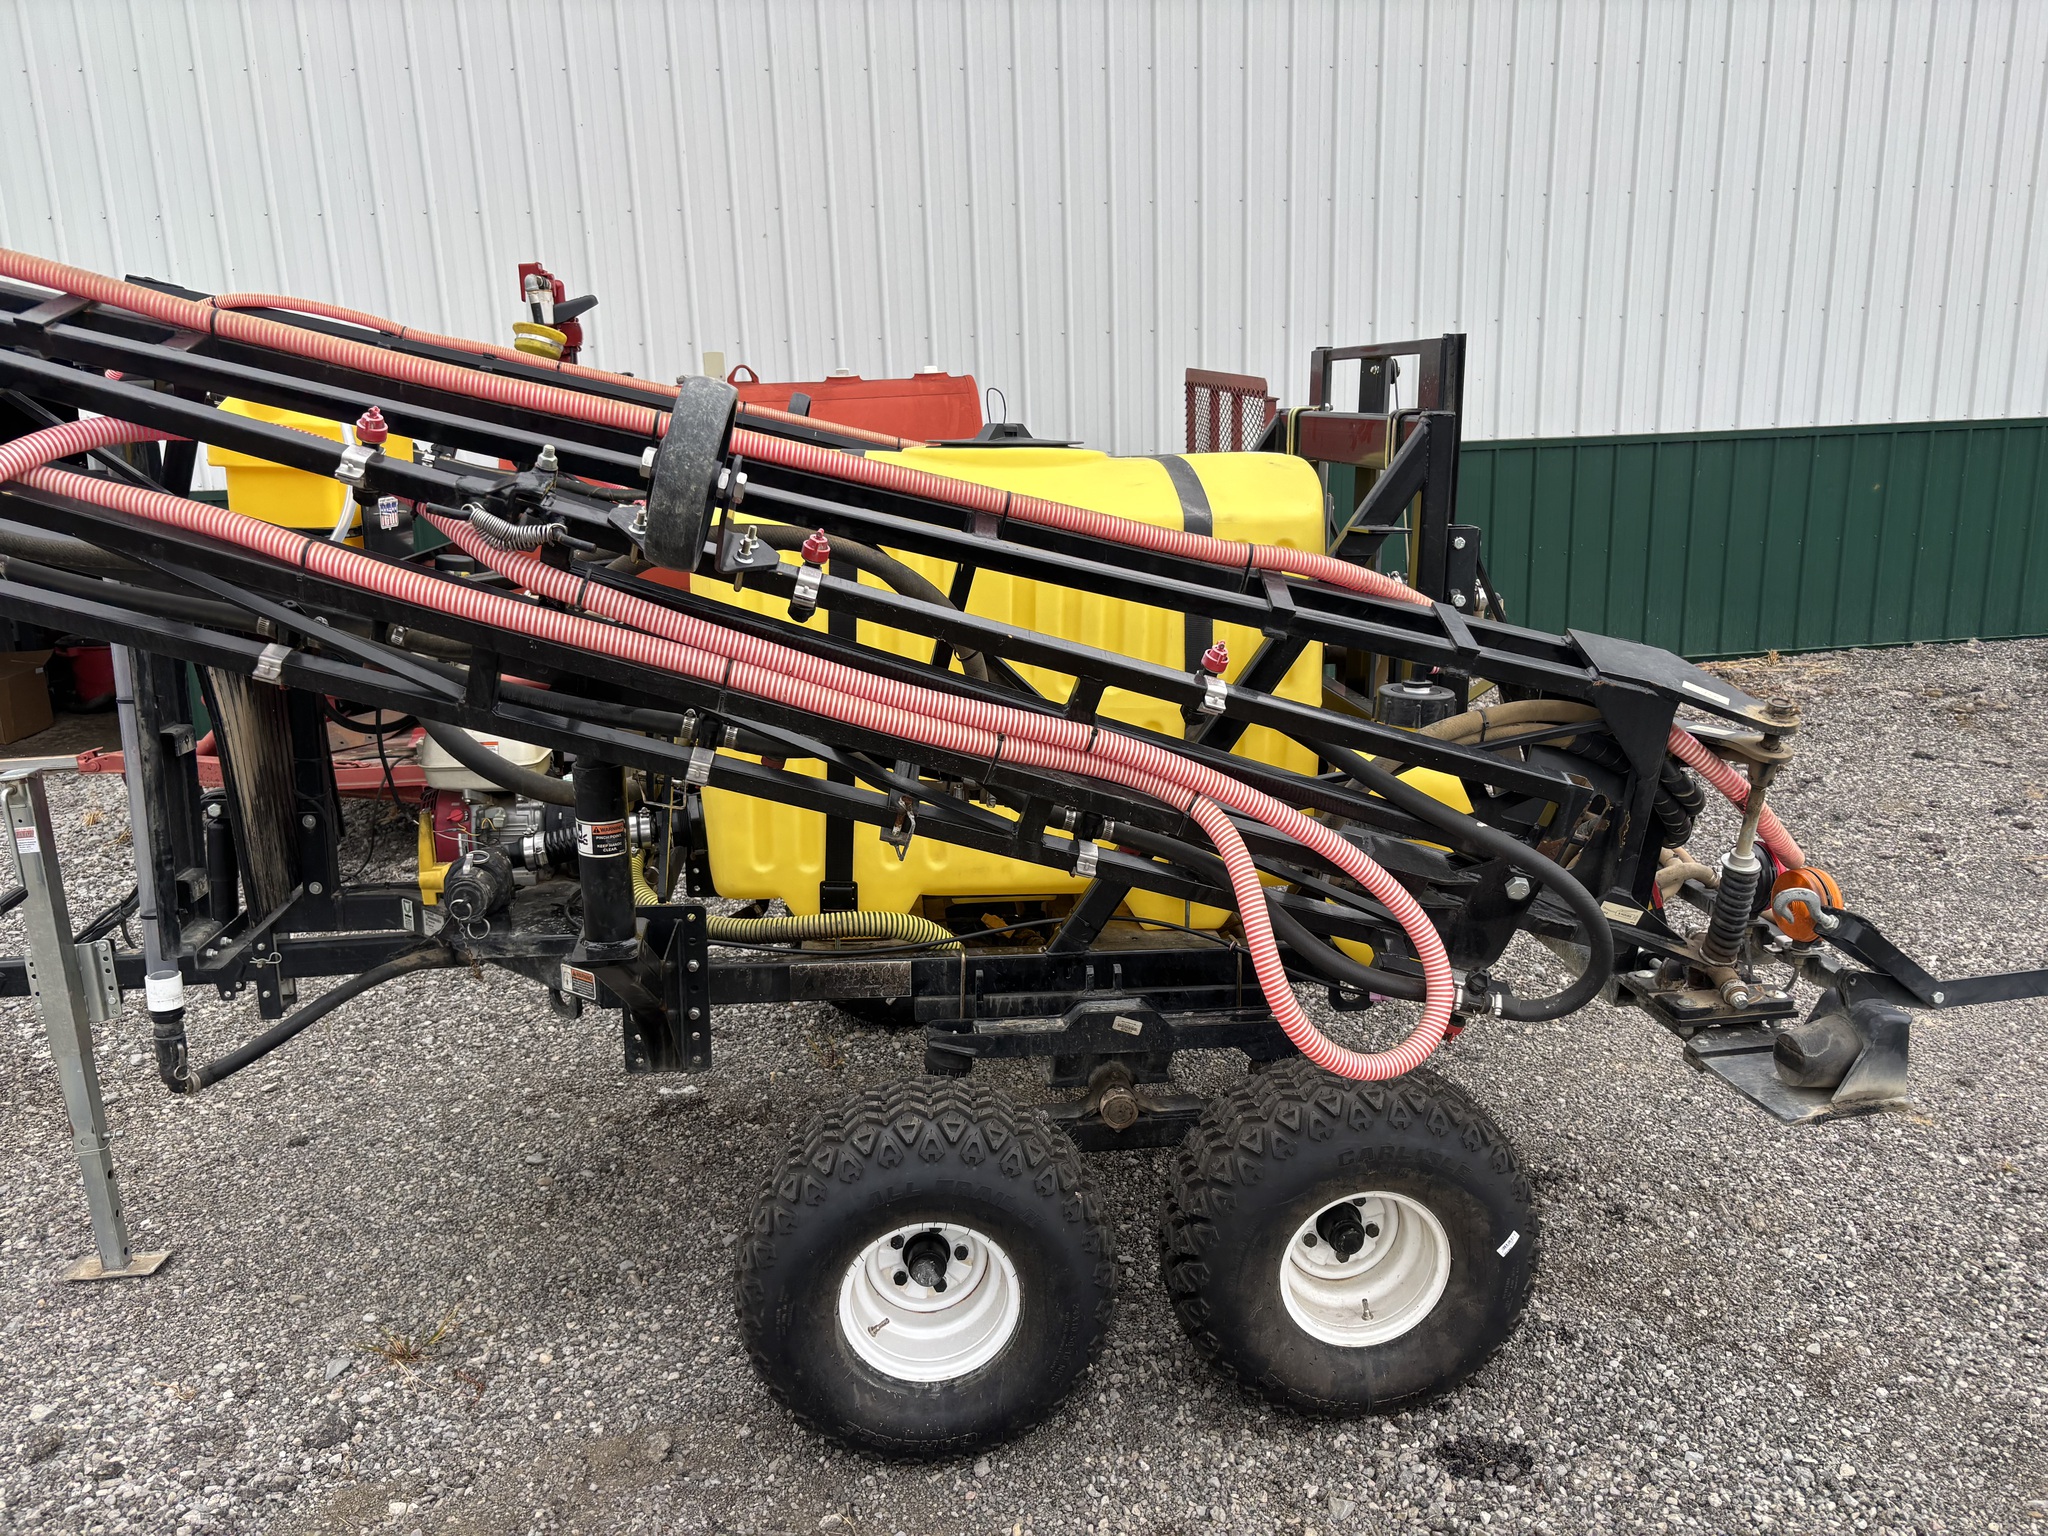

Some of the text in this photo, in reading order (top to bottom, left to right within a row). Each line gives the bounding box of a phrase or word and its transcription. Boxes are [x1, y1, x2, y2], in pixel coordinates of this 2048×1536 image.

[600, 824, 623, 832] WARNING
[1338, 1145, 1473, 1183] CARLISLE
[869, 1181, 922, 1209] ALL
[935, 1179, 1016, 1212] TRAIL
